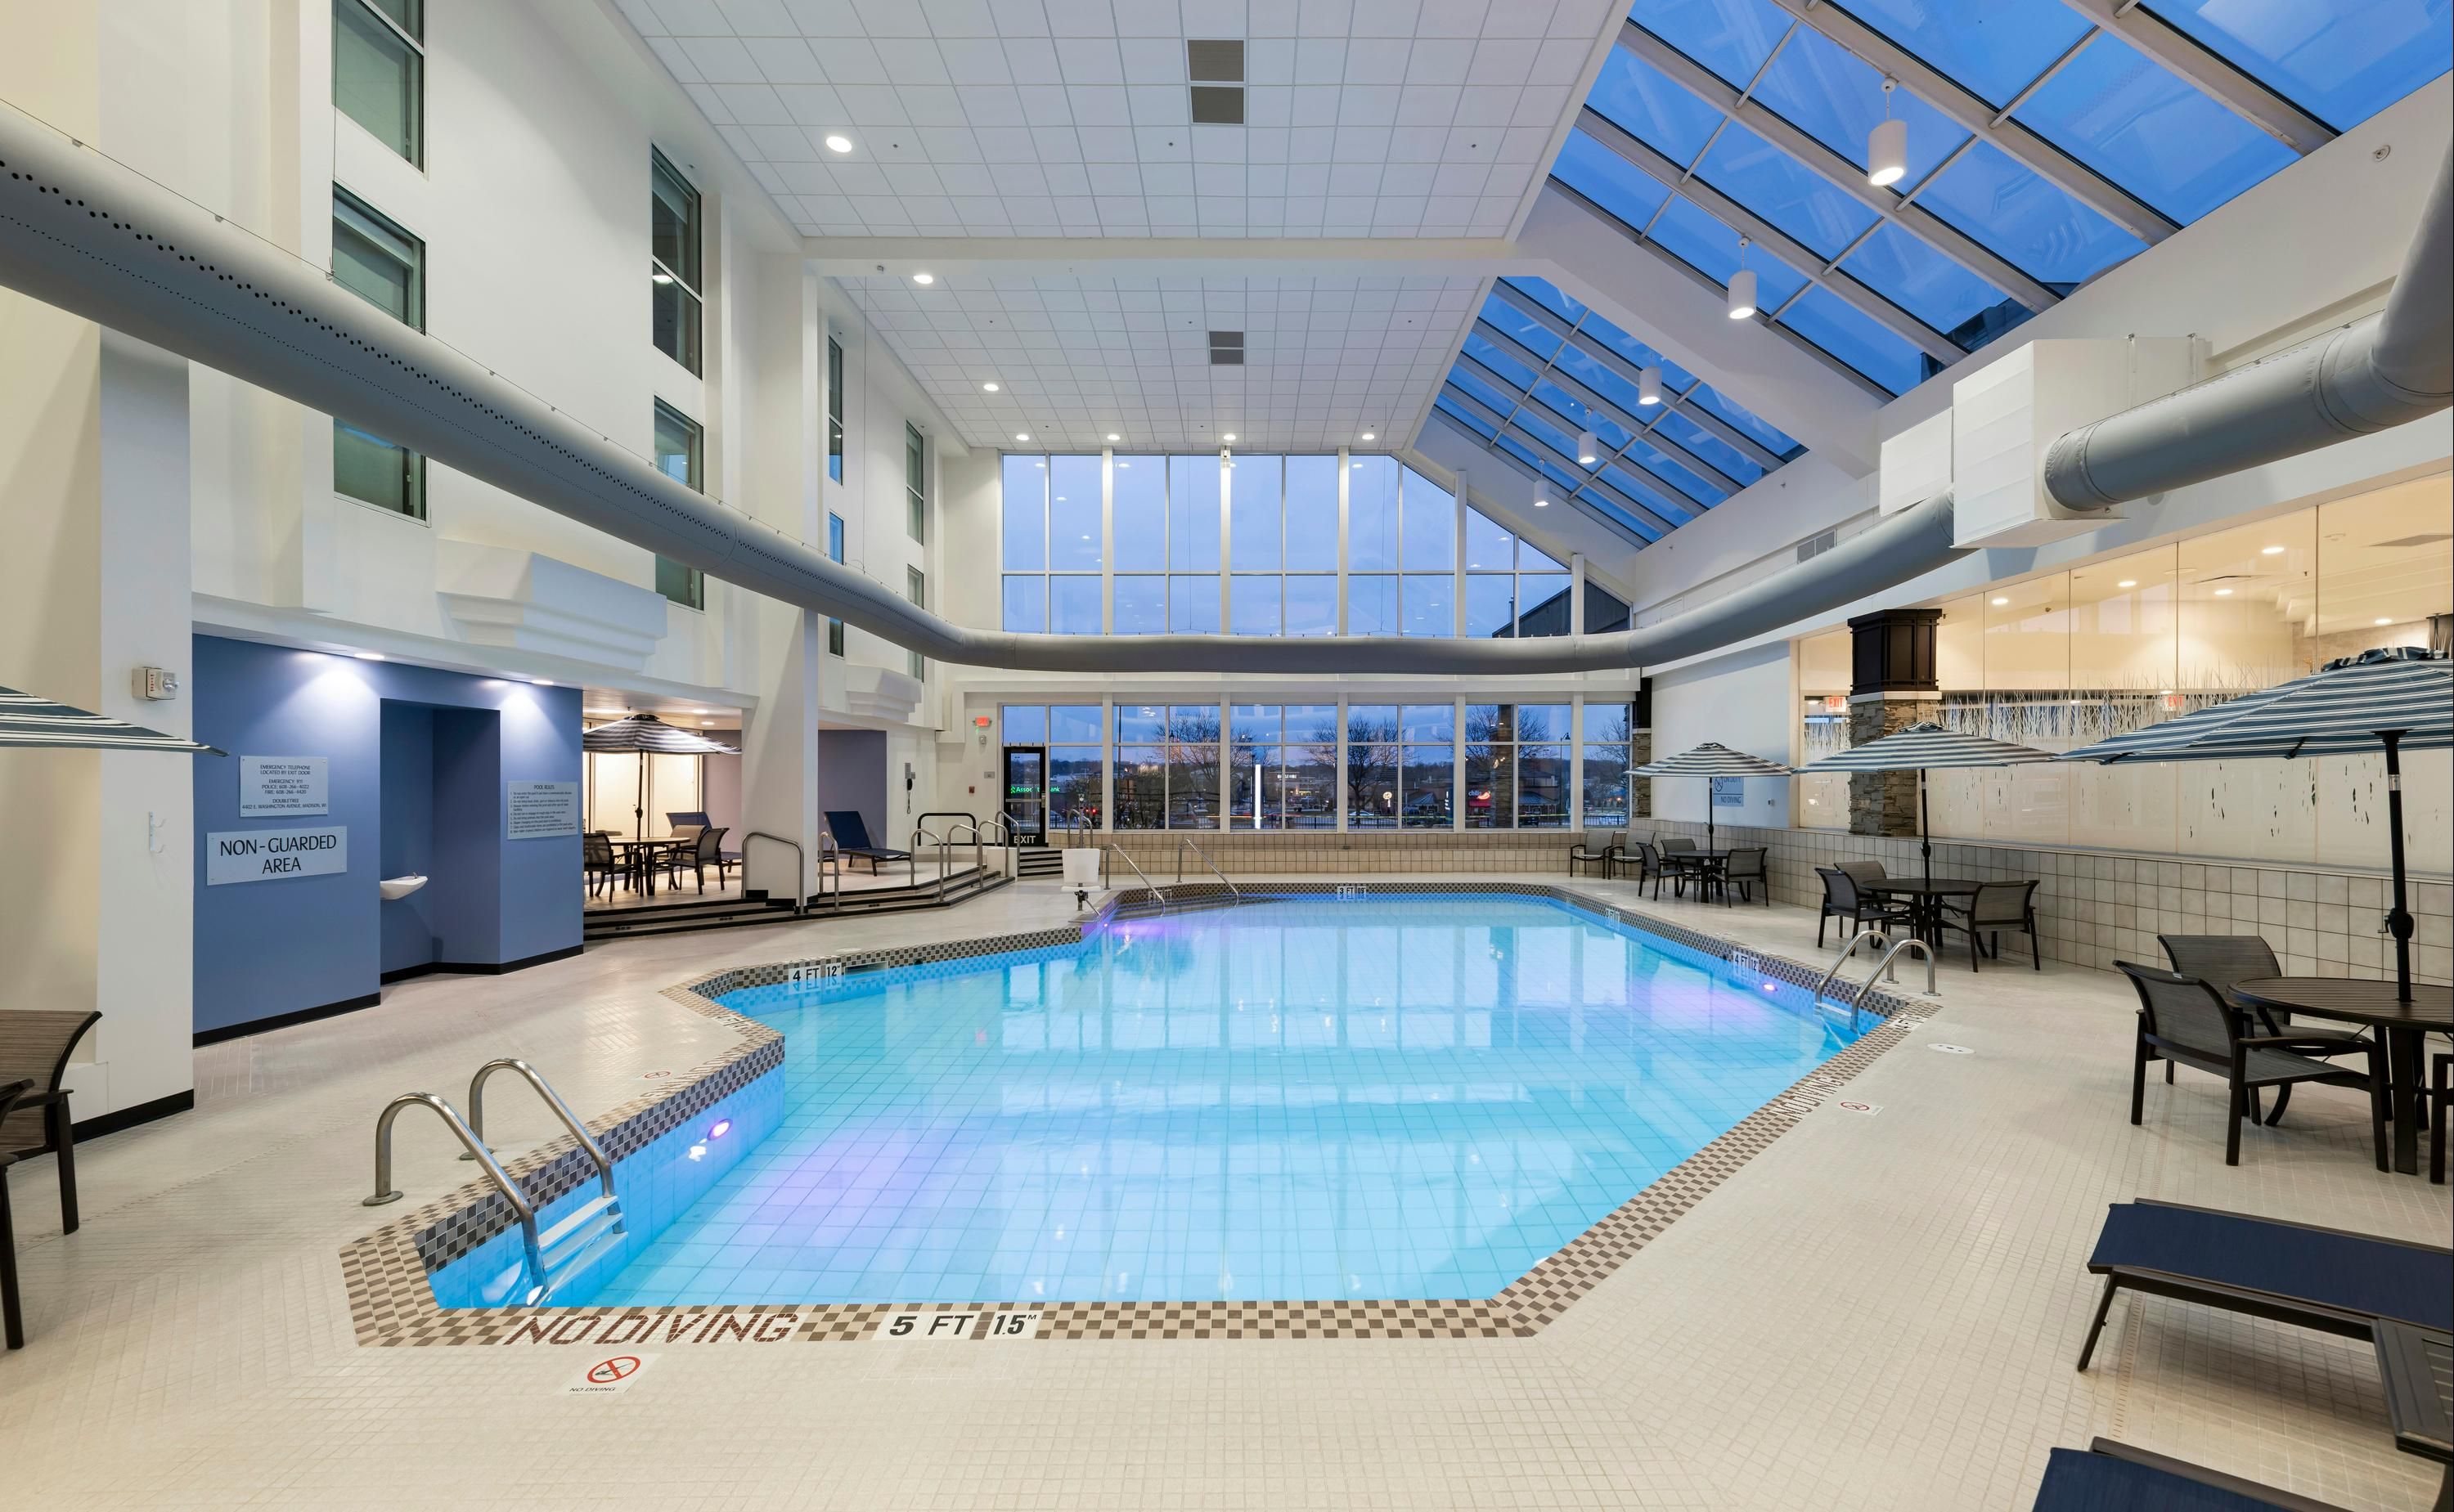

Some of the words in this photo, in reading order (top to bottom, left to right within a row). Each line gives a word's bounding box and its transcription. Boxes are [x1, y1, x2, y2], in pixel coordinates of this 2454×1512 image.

[1828, 698, 1843, 707] EXIT
[262, 857, 302, 874] AREA
[1735, 954, 1739, 965] 4
[1741, 956, 1747, 967] FT
[793, 970, 801, 981] 4
[806, 968, 819, 980] FT
[502, 1315, 602, 1345] NO
[595, 1313, 799, 1344] DIVING
[889, 1316, 918, 1335] 5
[928, 1315, 974, 1335] FT
